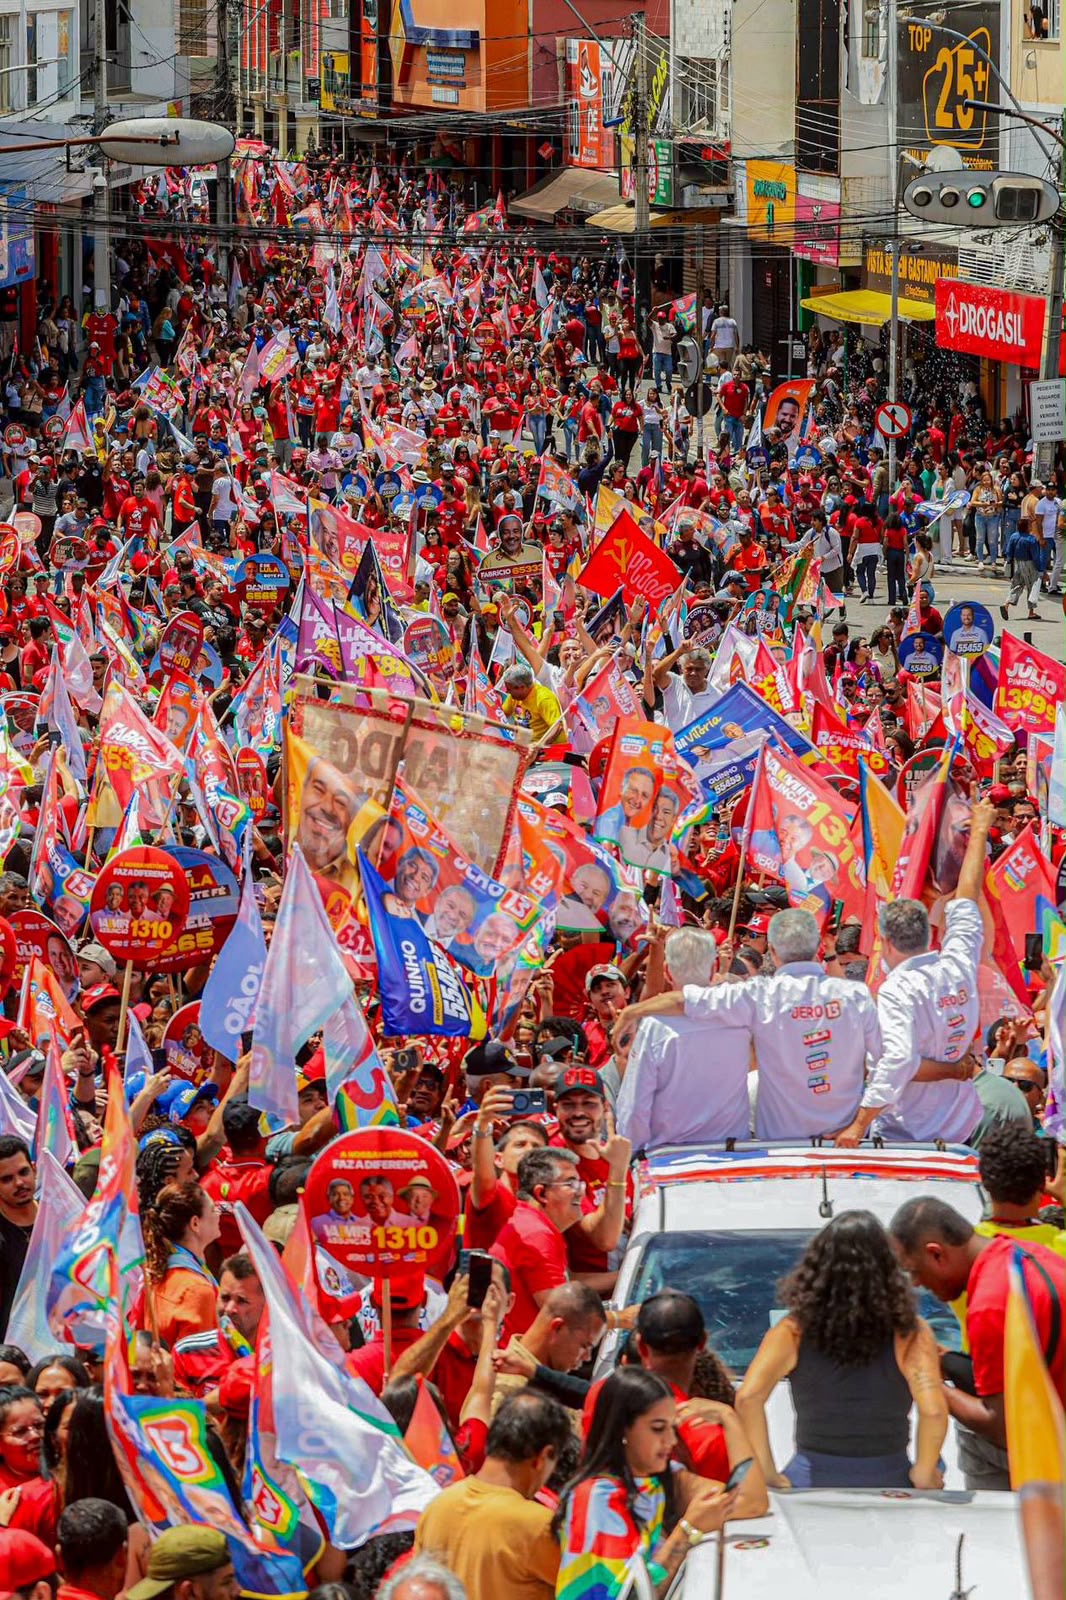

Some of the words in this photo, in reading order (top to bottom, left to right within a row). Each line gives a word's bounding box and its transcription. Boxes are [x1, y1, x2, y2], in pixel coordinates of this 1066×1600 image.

[908, 25, 932, 52] TOP
[935, 47, 986, 130] 25+
[867, 249, 884, 274] VISTA
[908, 256, 940, 284] GASTANDO
[959, 302, 1026, 347] DROGASIL
[1036, 420, 1064, 428] ATRAVESSE
[480, 568, 511, 578] FABRÍCIO
[626, 551, 674, 599] PCdoB
[957, 642, 983, 653] 55455
[910, 664, 932, 672] 55455
[714, 773, 742, 794] 55455
[216, 800, 239, 827] 13
[68, 871, 96, 898] 13
[113, 868, 127, 876] FAZ
[133, 869, 174, 879] DIFERENÇA
[504, 890, 532, 918] 13
[130, 919, 173, 940] 1310
[791, 1005, 823, 1019] JERO
[826, 1001, 841, 1019] 13
[332, 1159, 355, 1170] FAZ
[355, 1160, 363, 1170] A
[363, 1159, 429, 1172] DIFERENÇA
[322, 1224, 371, 1238] VALMIR
[373, 1225, 439, 1250] 1310
[146, 1426, 200, 1473] 13
[252, 1471, 281, 1524] 13
